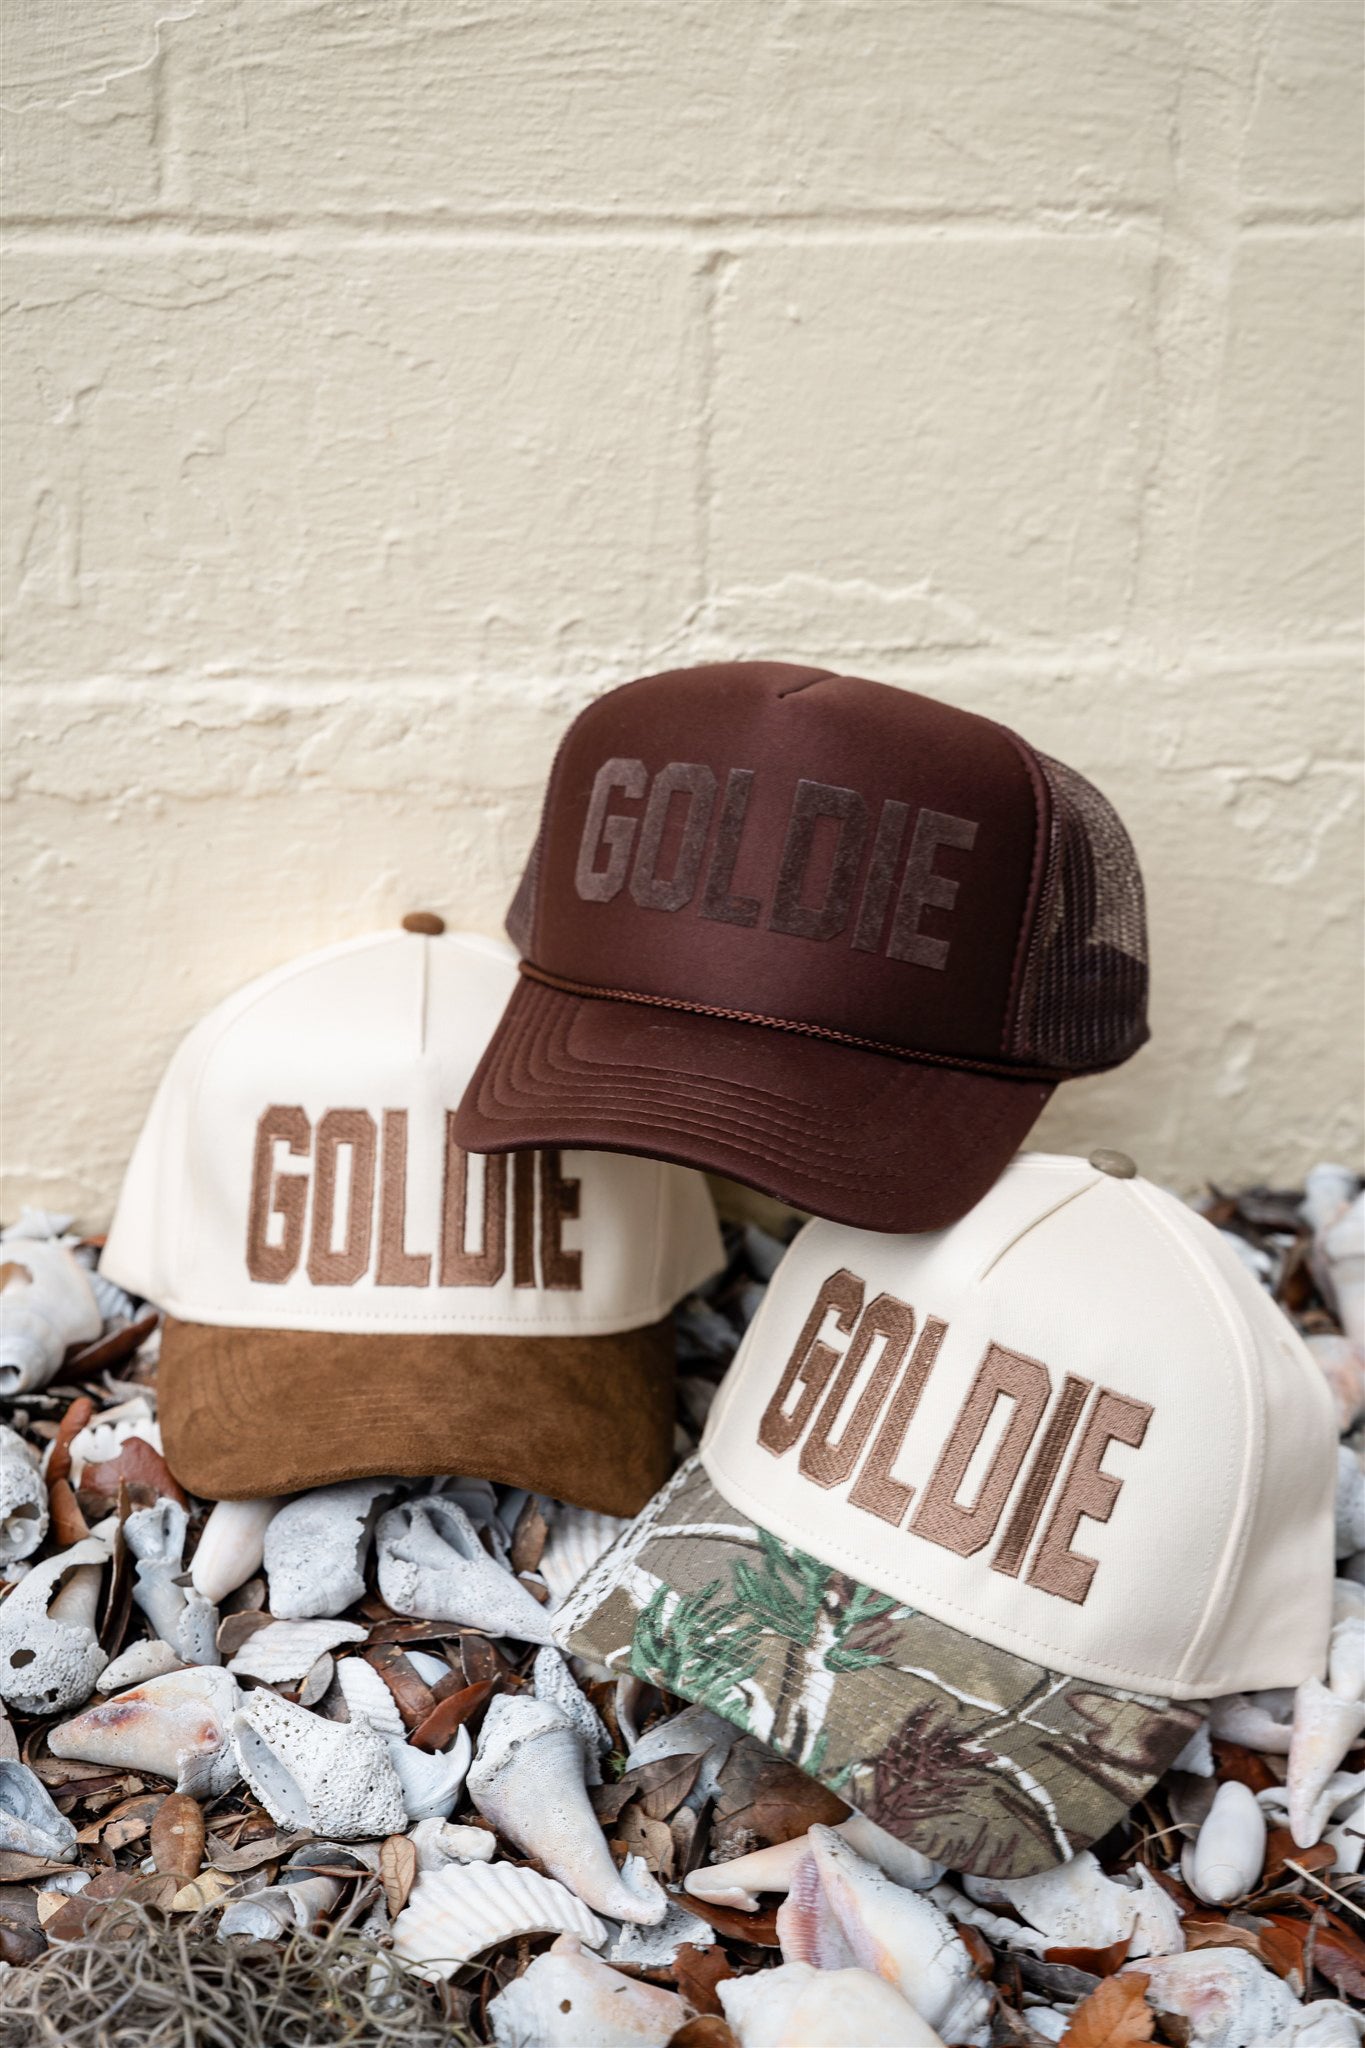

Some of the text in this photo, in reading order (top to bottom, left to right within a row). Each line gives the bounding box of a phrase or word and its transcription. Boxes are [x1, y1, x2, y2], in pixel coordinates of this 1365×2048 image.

[574, 757, 979, 970] GOLDIE
[246, 1104, 582, 1290] GOLDIE
[757, 1268, 1155, 1606] GOLDIE
